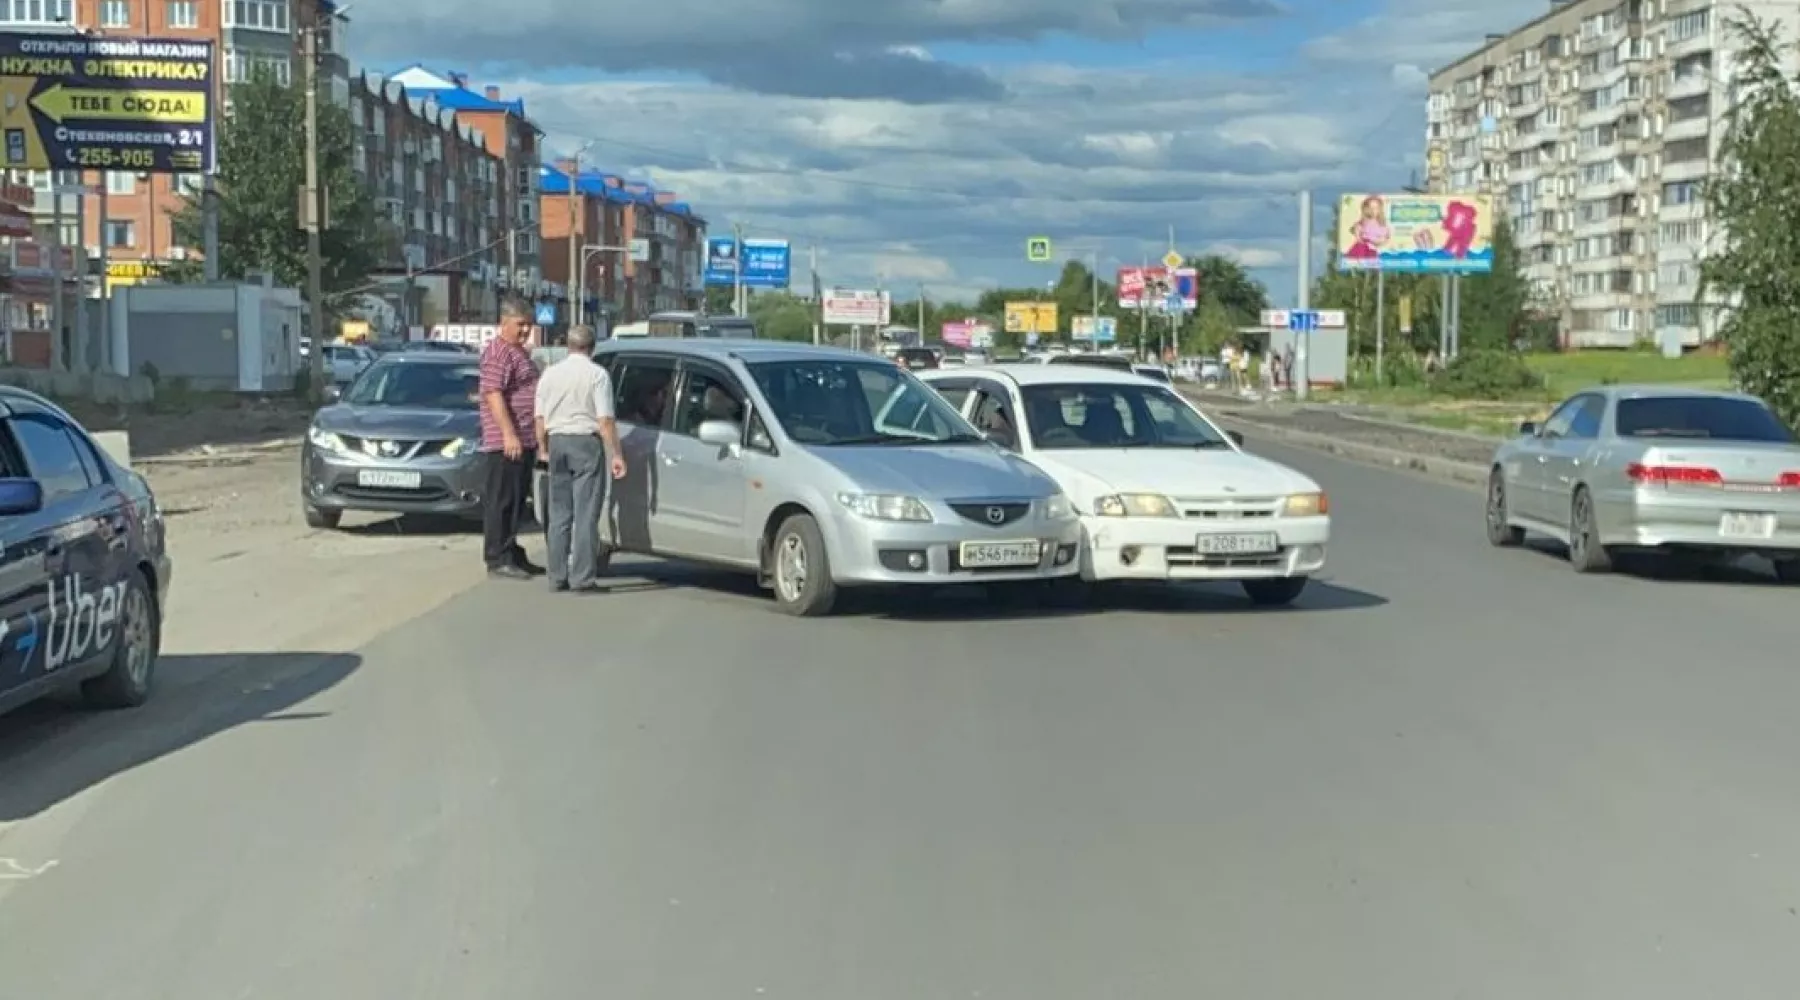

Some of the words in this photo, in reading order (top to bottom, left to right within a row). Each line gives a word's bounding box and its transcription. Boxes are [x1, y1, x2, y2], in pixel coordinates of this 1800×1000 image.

[20, 40, 86, 54] ОТКРЫЛИ
[88, 39, 140, 56] НОВЫЙ
[141, 43, 207, 57] МАГАЗИН
[1, 57, 75, 76] НУЖНА
[83, 59, 209, 80] ЭЛЕКТРИКА?
[69, 95, 111, 111] ТЕБЕ
[121, 98, 192, 114] СЮДА!
[54, 127, 176, 146] Стахановская,
[178, 130, 204, 146] 2/1
[78, 147, 155, 167] 255-905
[45, 572, 128, 671] Uber
